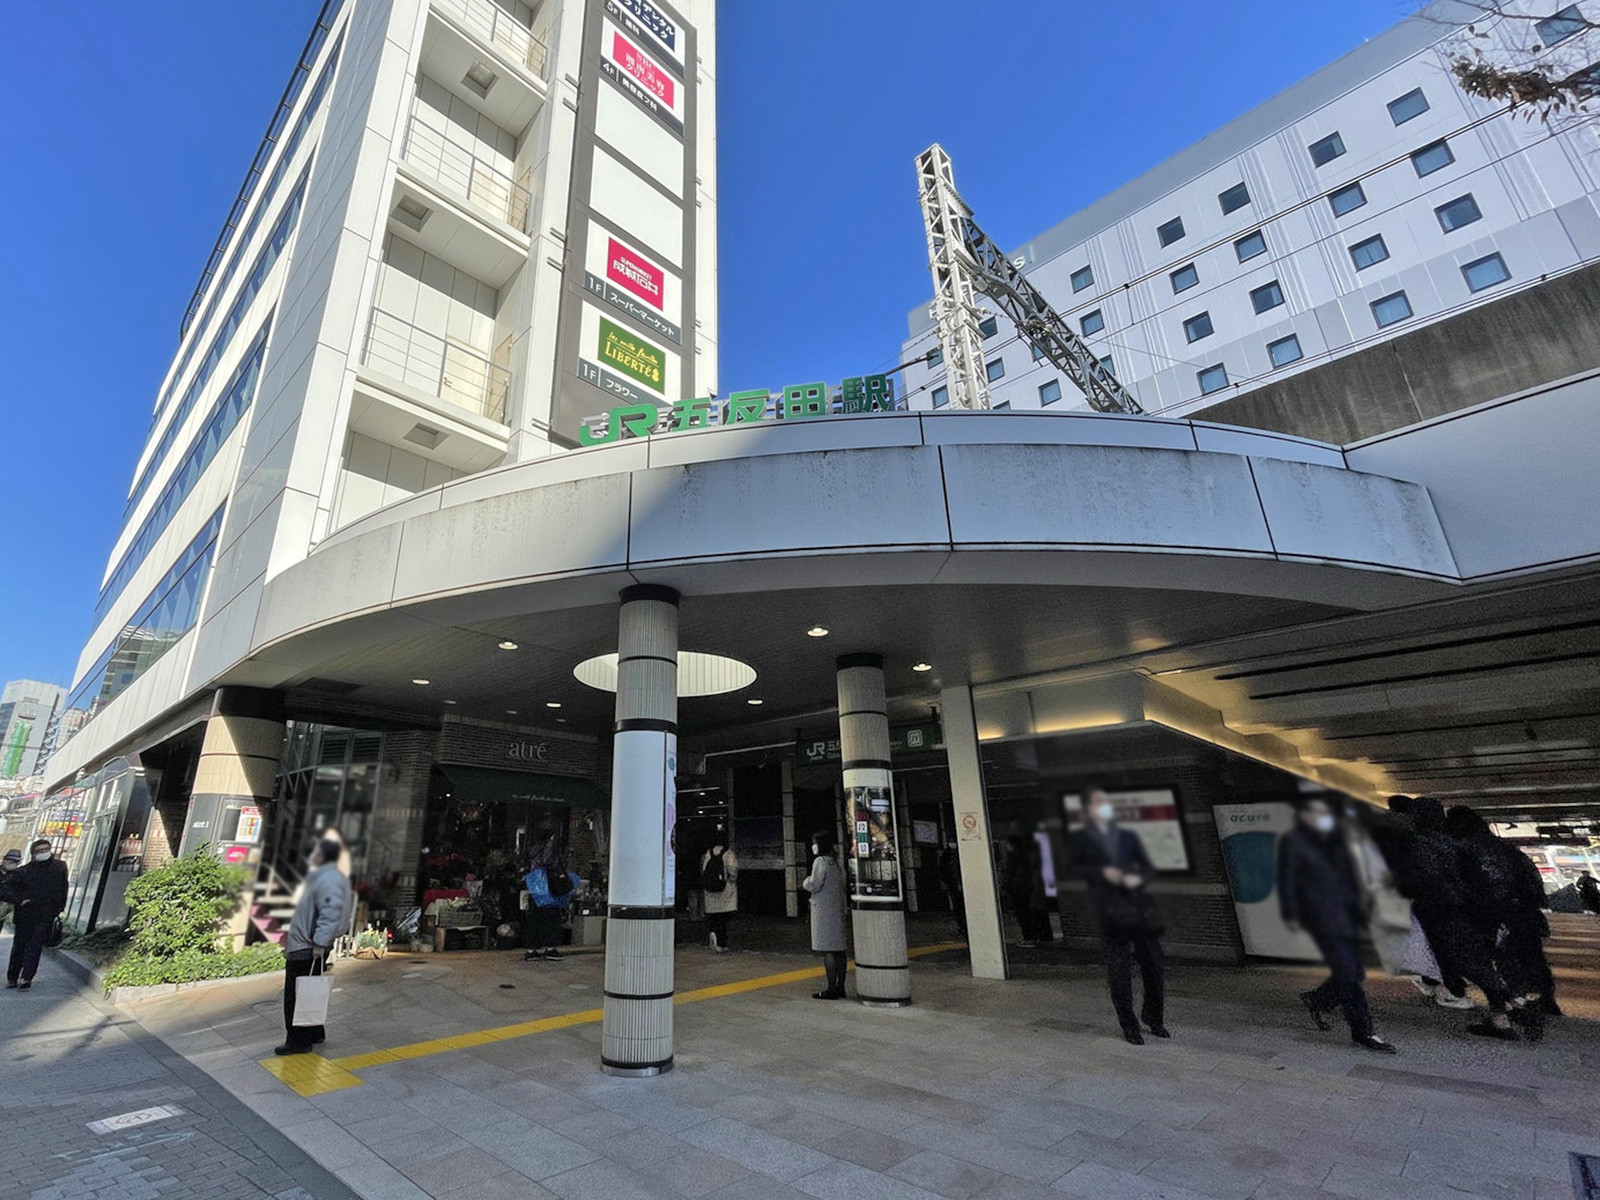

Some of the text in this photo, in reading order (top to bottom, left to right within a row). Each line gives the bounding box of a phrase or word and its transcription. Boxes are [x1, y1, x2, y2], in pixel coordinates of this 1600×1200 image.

[603, 63, 615, 75] 4F
[589, 277, 675, 336] 1F スーパーマーケット
[583, 364, 638, 399] 1F フラワー
[806, 742, 825, 757] JR
